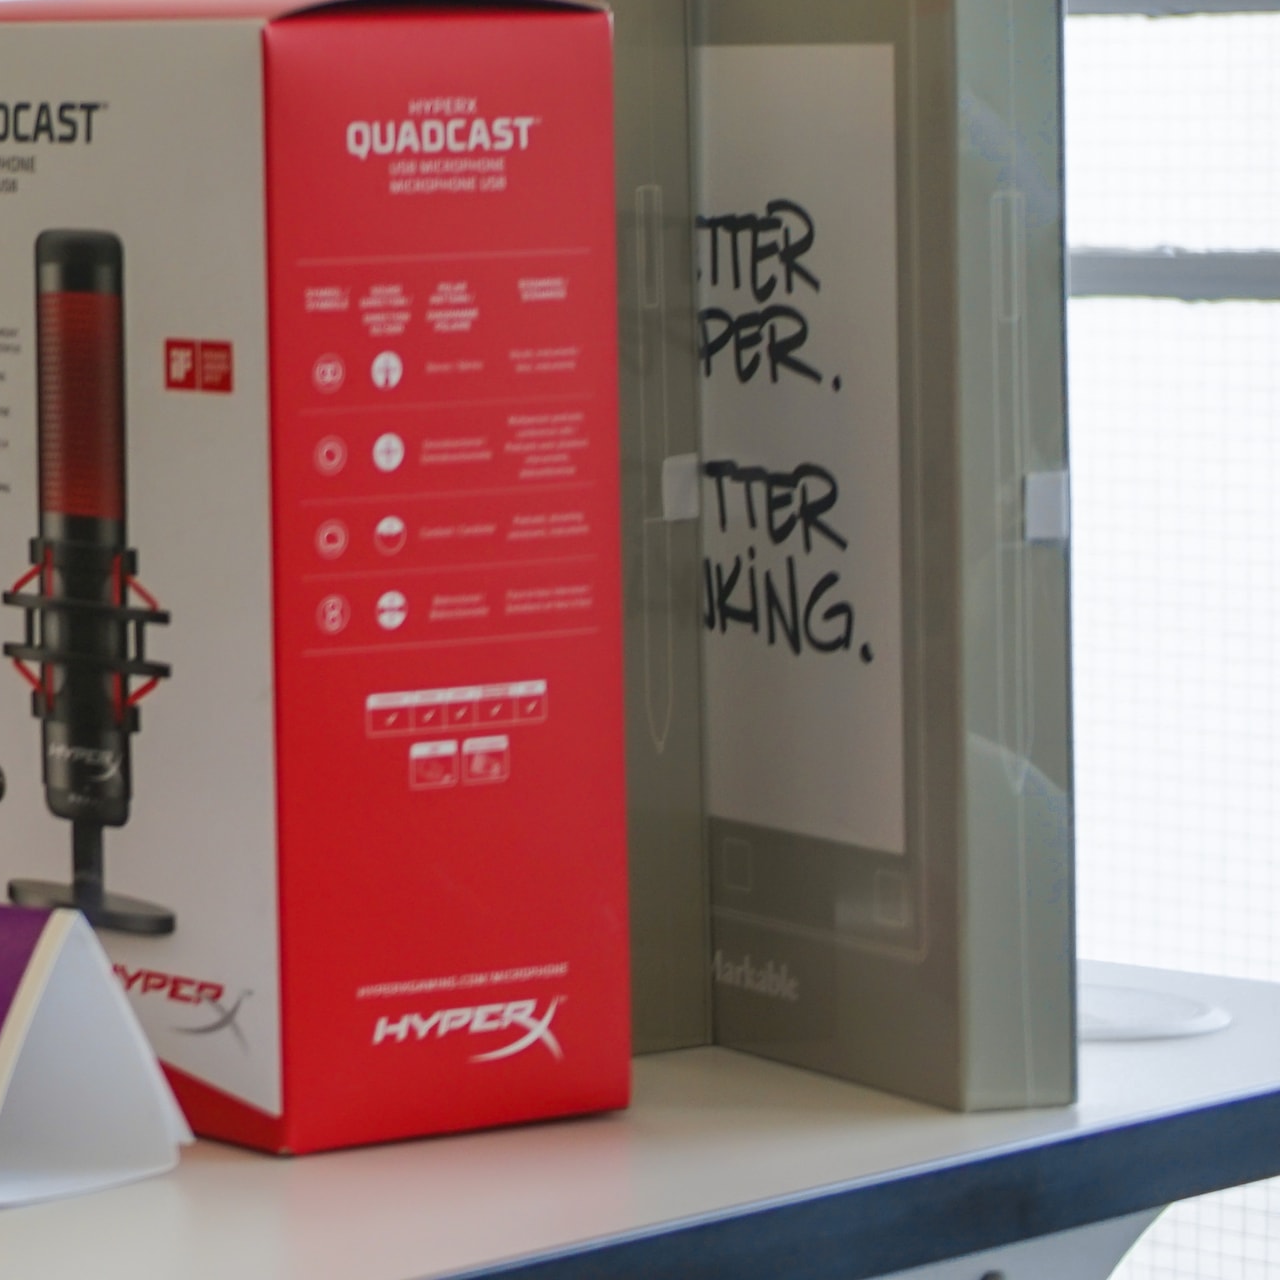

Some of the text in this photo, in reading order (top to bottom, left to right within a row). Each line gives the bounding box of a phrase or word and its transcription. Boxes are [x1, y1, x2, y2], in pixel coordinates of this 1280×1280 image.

[408, 96, 478, 115] HYPERX
[388, 176, 507, 195] MICROPHONE USB
[389, 156, 506, 176] USB MICROPHONE
[694, 198, 820, 304] TTER
[696, 304, 842, 393] PER.
[700, 462, 848, 554] TTER
[371, 995, 568, 1066] HYPERX
